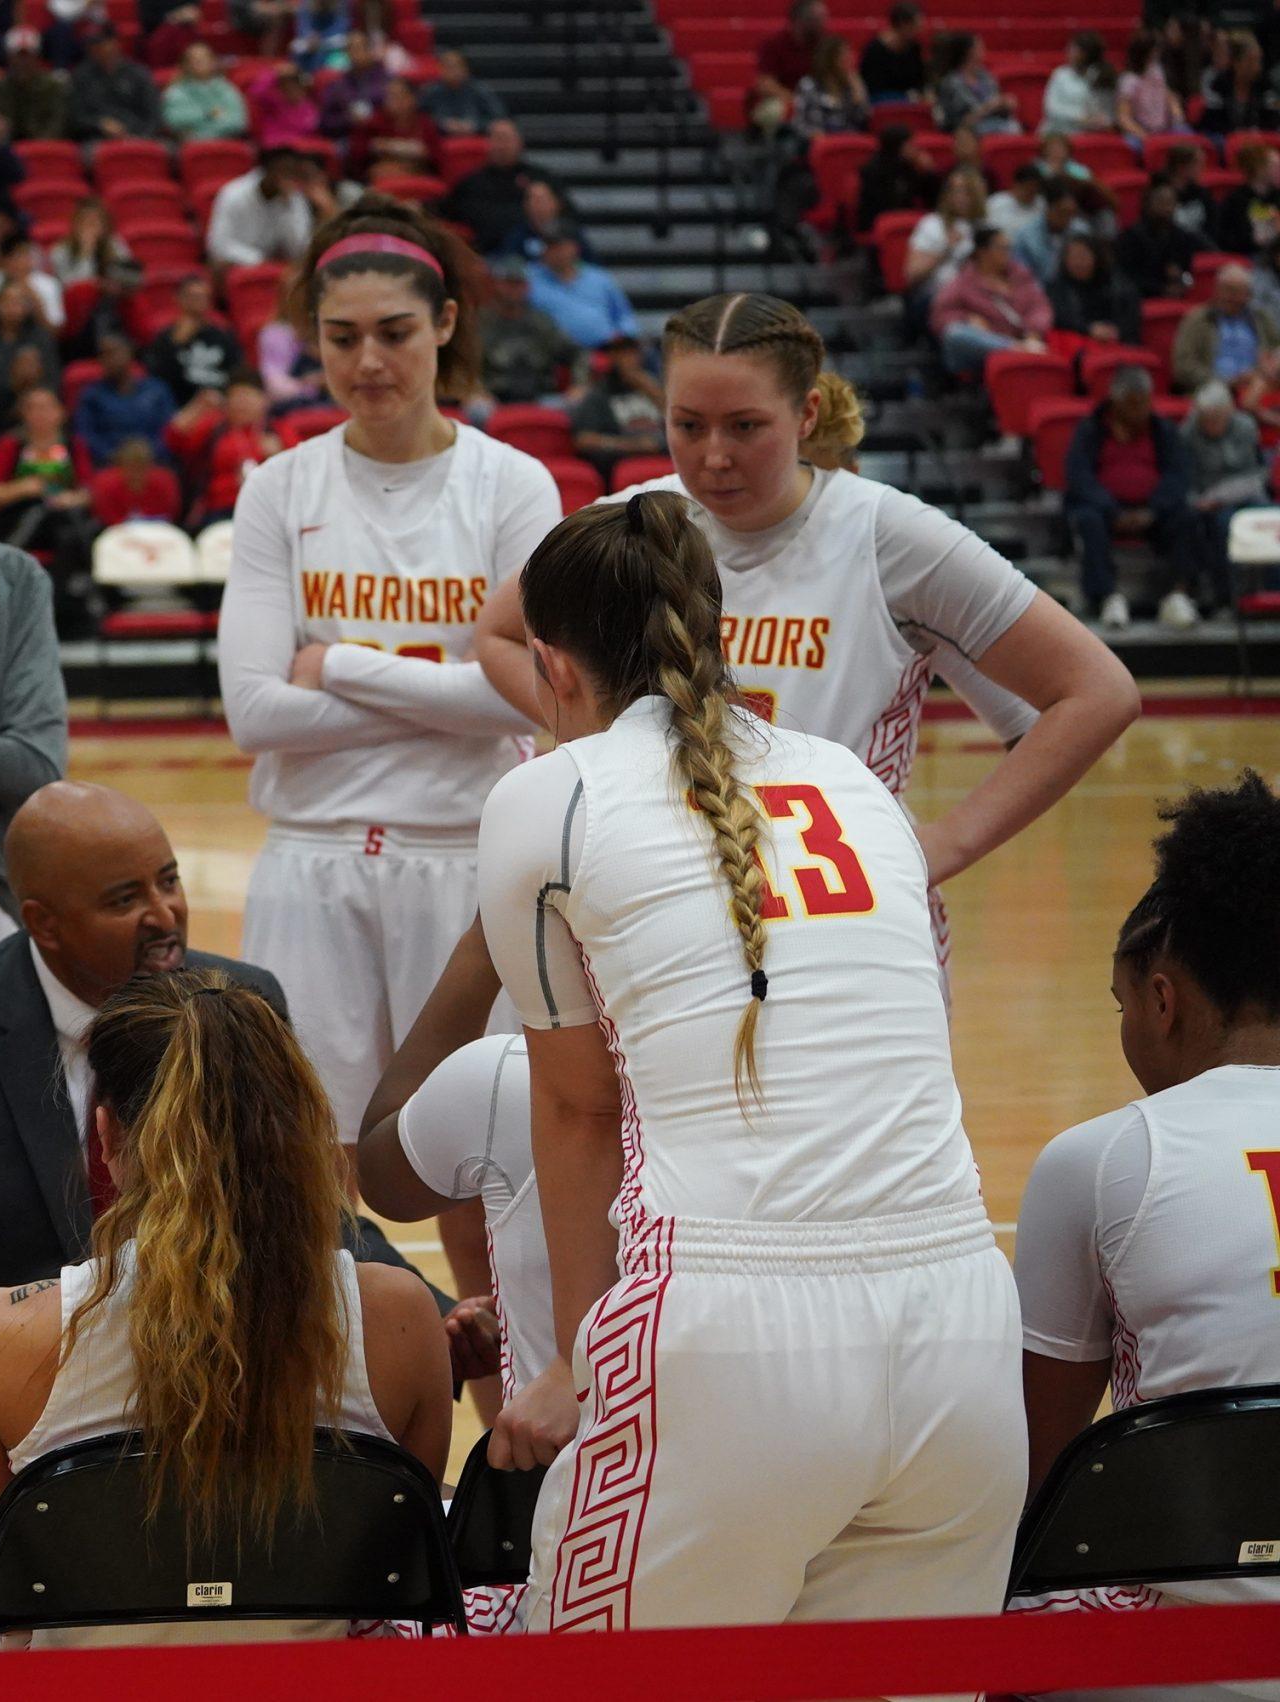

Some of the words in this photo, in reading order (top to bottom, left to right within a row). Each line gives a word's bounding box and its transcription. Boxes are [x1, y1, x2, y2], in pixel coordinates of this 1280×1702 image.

[301, 571, 487, 623] WARRIORS
[720, 616, 830, 670] RIORS
[1247, 1543, 1274, 1554] clarin
[195, 1585, 223, 1596] clarin
